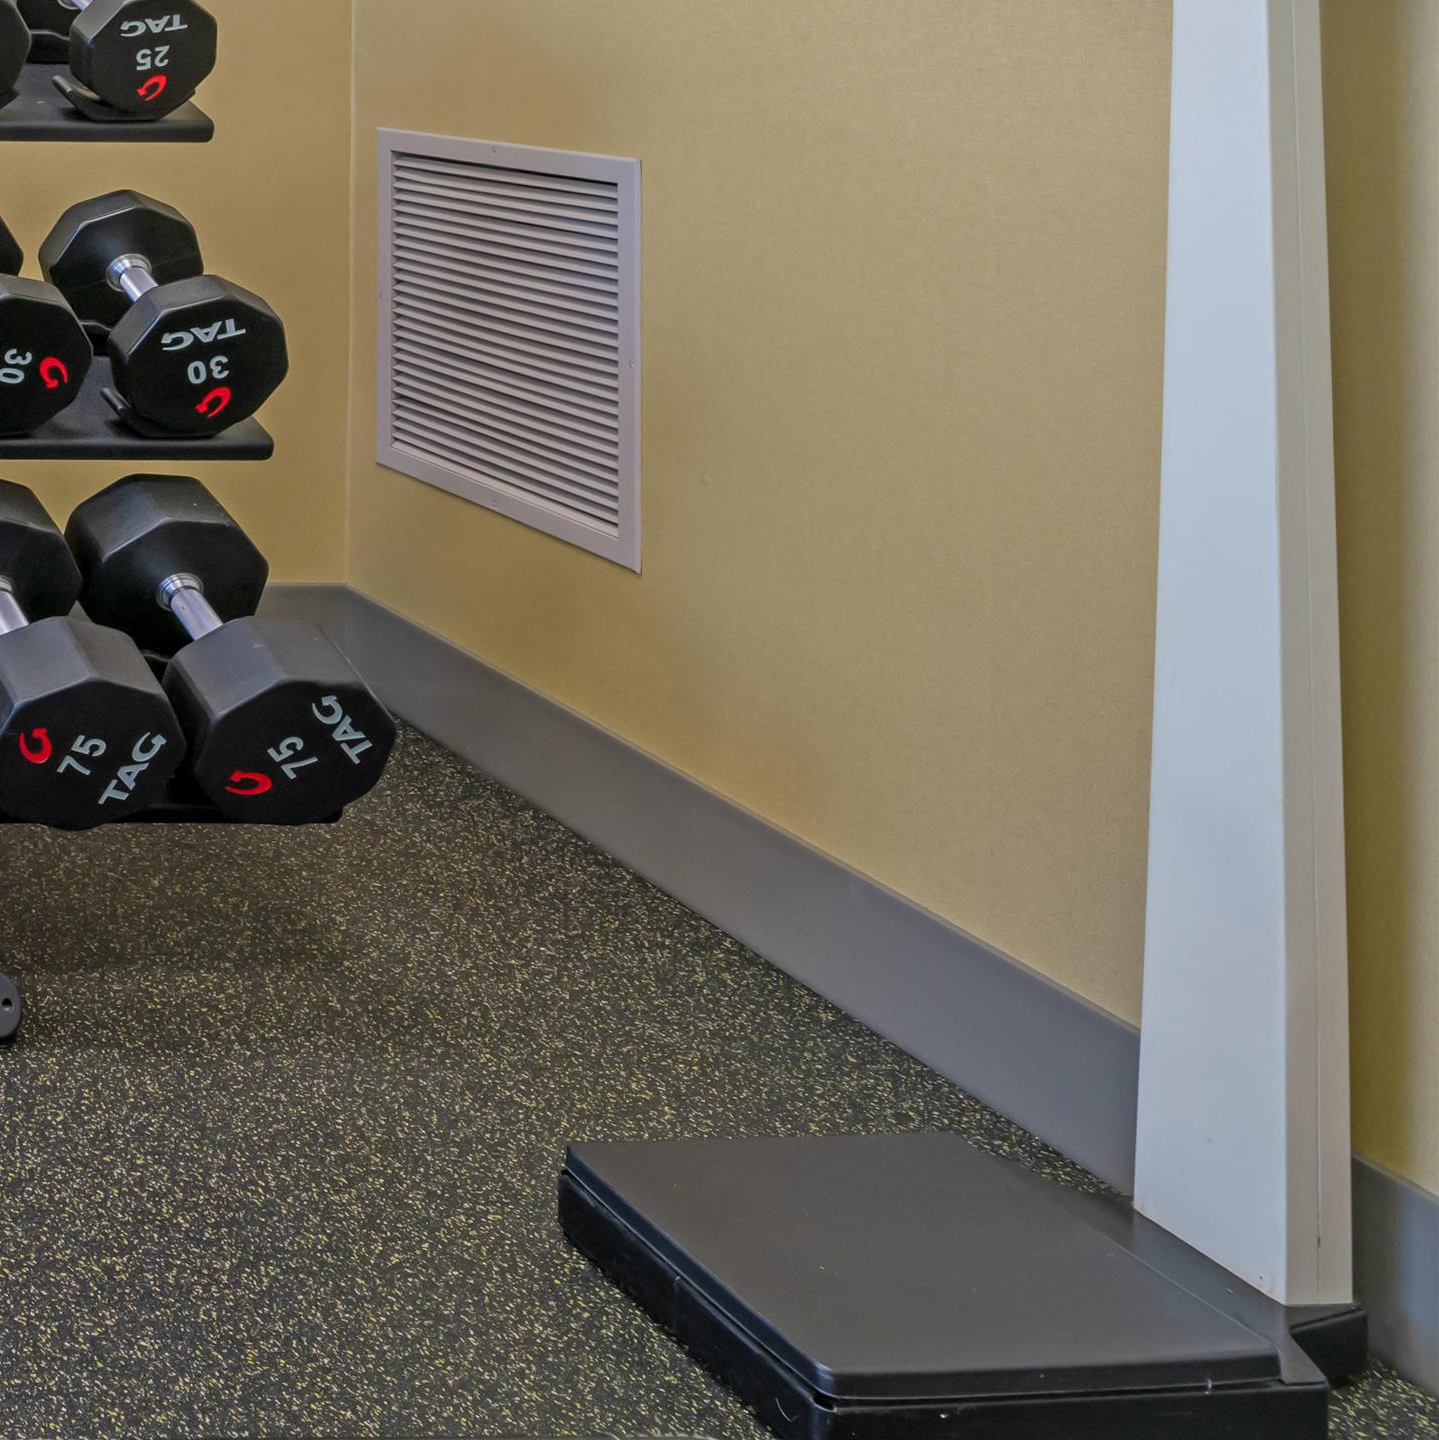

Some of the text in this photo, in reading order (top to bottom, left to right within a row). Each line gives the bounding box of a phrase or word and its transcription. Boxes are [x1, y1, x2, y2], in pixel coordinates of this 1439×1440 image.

[120, 13, 188, 38] TAG
[135, 45, 170, 71] 25
[311, 695, 373, 765] TAG
[56, 734, 107, 776] 75
[97, 731, 167, 805] TAG
[266, 736, 319, 780] 75
